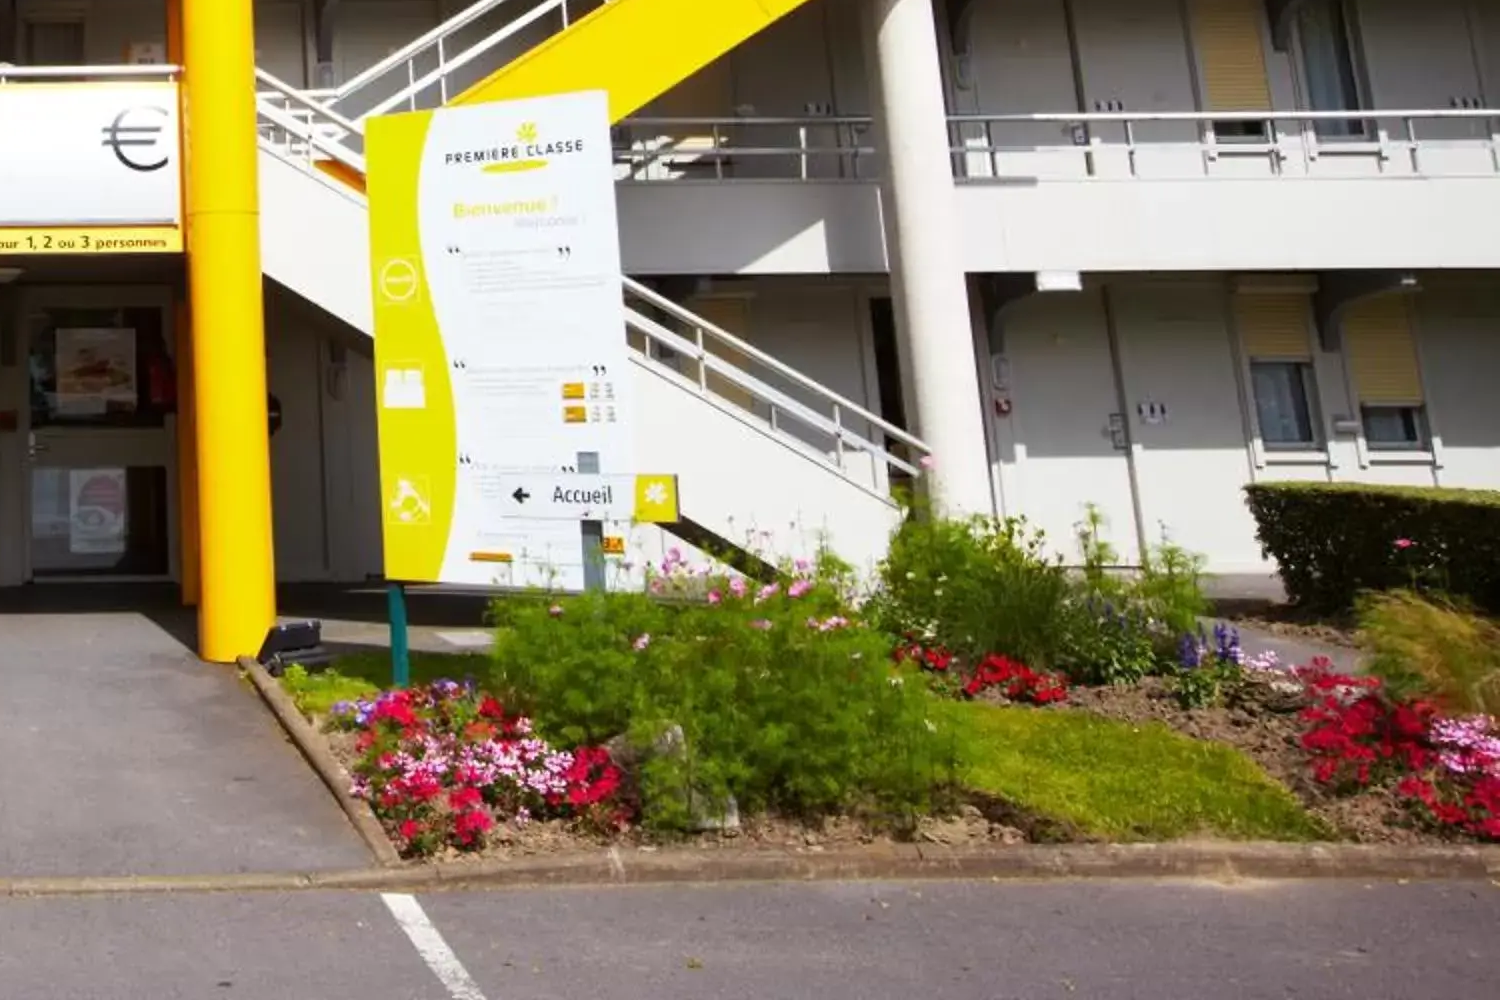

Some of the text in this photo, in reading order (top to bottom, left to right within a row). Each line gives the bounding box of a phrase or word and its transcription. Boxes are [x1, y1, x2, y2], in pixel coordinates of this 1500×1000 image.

[446, 139, 584, 164] PREMIERE CLASSE
[25, 236, 38, 251] 1,
[43, 235, 53, 249] 2
[57, 240, 76, 250] ou
[81, 235, 91, 249] 3
[95, 238, 168, 254] personnes
[552, 485, 613, 505] Accueil
